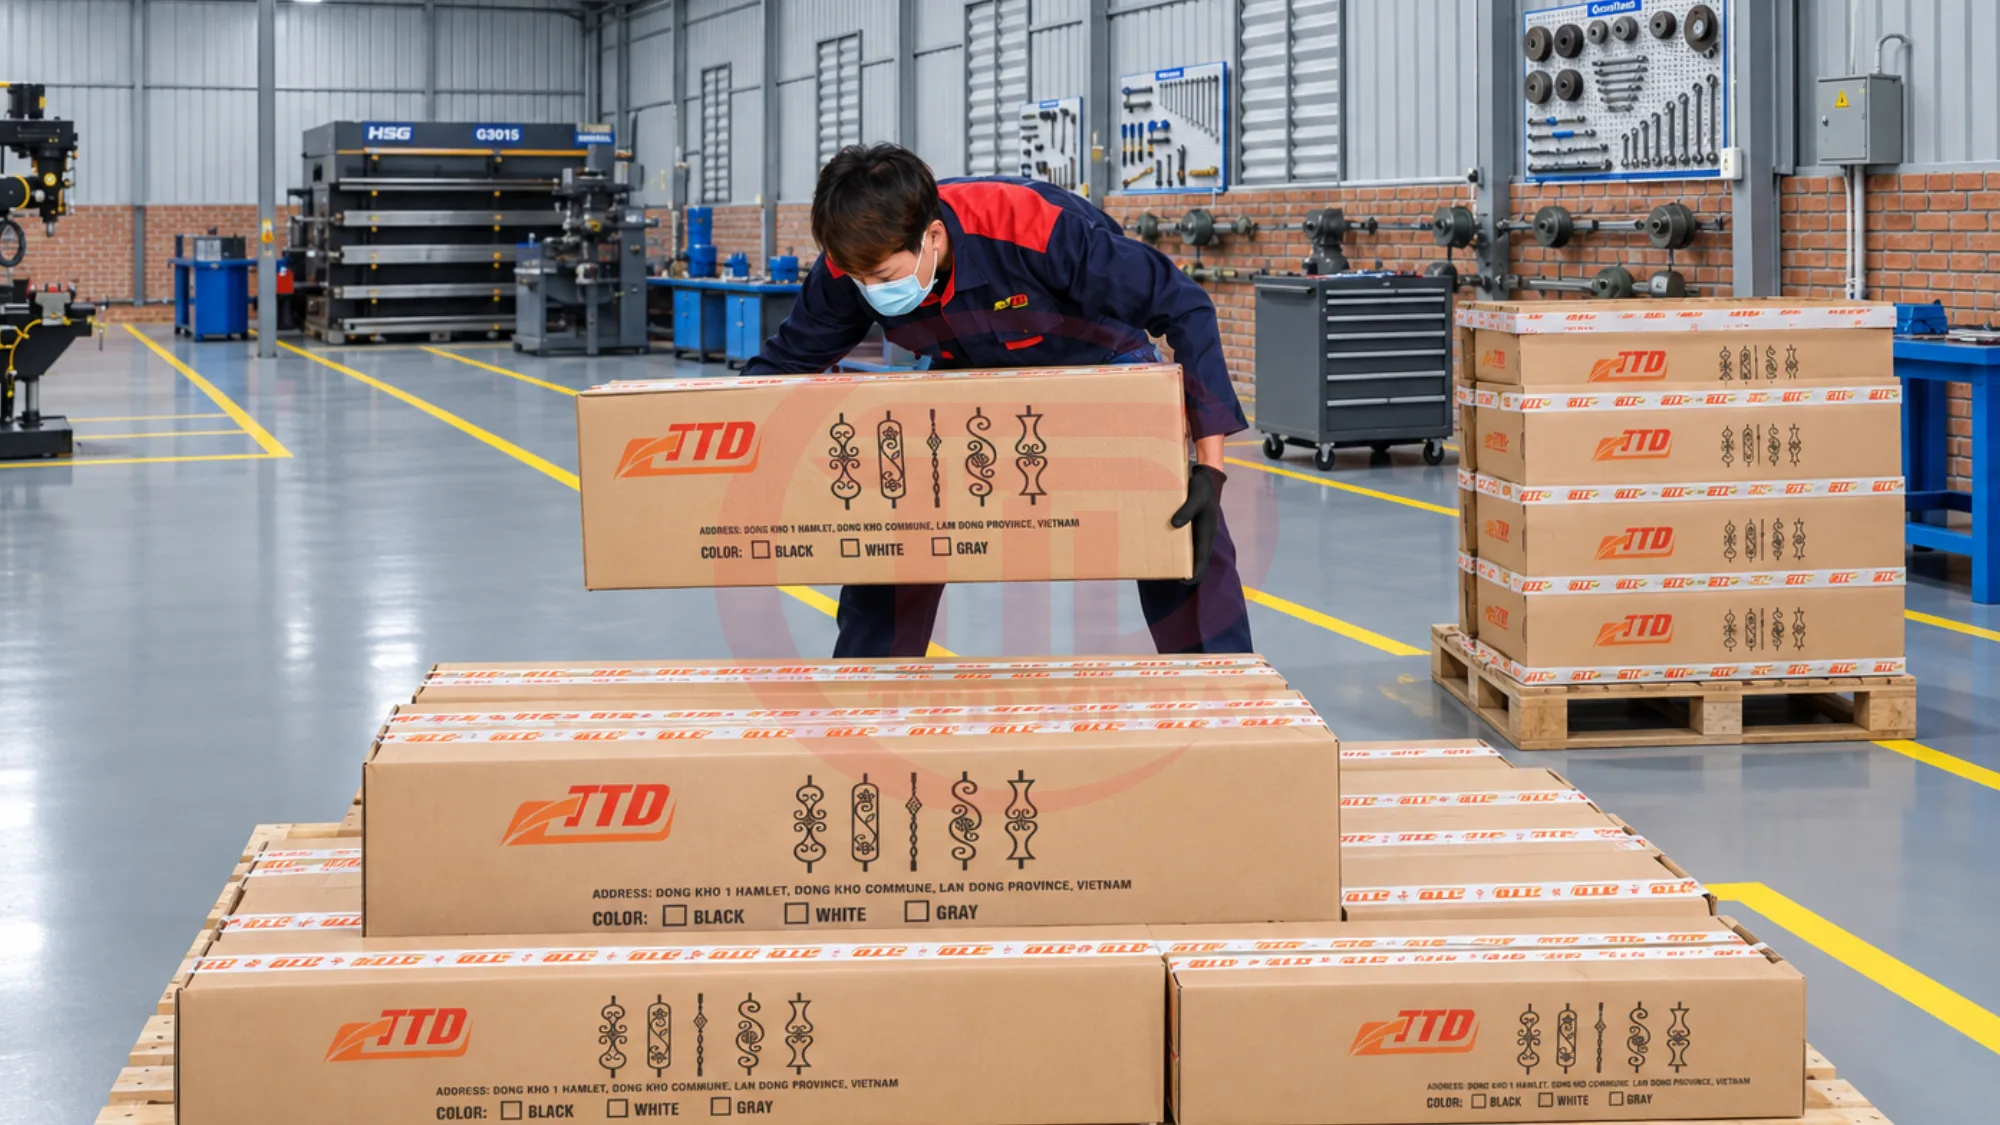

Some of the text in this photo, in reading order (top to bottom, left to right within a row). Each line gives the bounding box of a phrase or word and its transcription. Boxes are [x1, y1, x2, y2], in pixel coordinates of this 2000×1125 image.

[368, 126, 411, 140] HSG
[476, 128, 520, 141] G3015
[1616, 351, 1665, 372] TTD
[667, 421, 755, 460] TTD
[1622, 430, 1670, 451] TTD
[1624, 528, 1672, 550] TTD
[701, 541, 988, 559] COLOR: BLACK WHITE GRAY
[1624, 615, 1671, 636] TTD
[565, 785, 669, 826] TTD
[592, 880, 1131, 899] ADDRESS: DONG KHO 1 HAMLET, DONG KHO COMMUNE, LAN DONG PROVINCE, VIETNAM
[592, 905, 978, 926] COLOR: BLACK WHITE GRAY
[378, 1009, 466, 1045] TTD
[1395, 1010, 1474, 1041] TTD
[436, 1086, 489, 1096] ADDRESS:
[493, 1086, 523, 1095] DONG
[527, 1085, 549, 1094] KHO
[562, 1084, 608, 1094] HAMLET,
[612, 1084, 642, 1093] DONG
[646, 1083, 668, 1092] KHO
[734, 1081, 755, 1090] LAN
[759, 1081, 788, 1090] DONG
[792, 1080, 847, 1089] PROVINCE,
[851, 1078, 898, 1088] VIETNAM
[436, 1100, 773, 1120] COLOR: BLACK WHITE GRAY
[1490, 1096, 1521, 1107] BLACK
[1557, 1095, 1589, 1106] WHITE
[1627, 1094, 1652, 1105] GRAY
